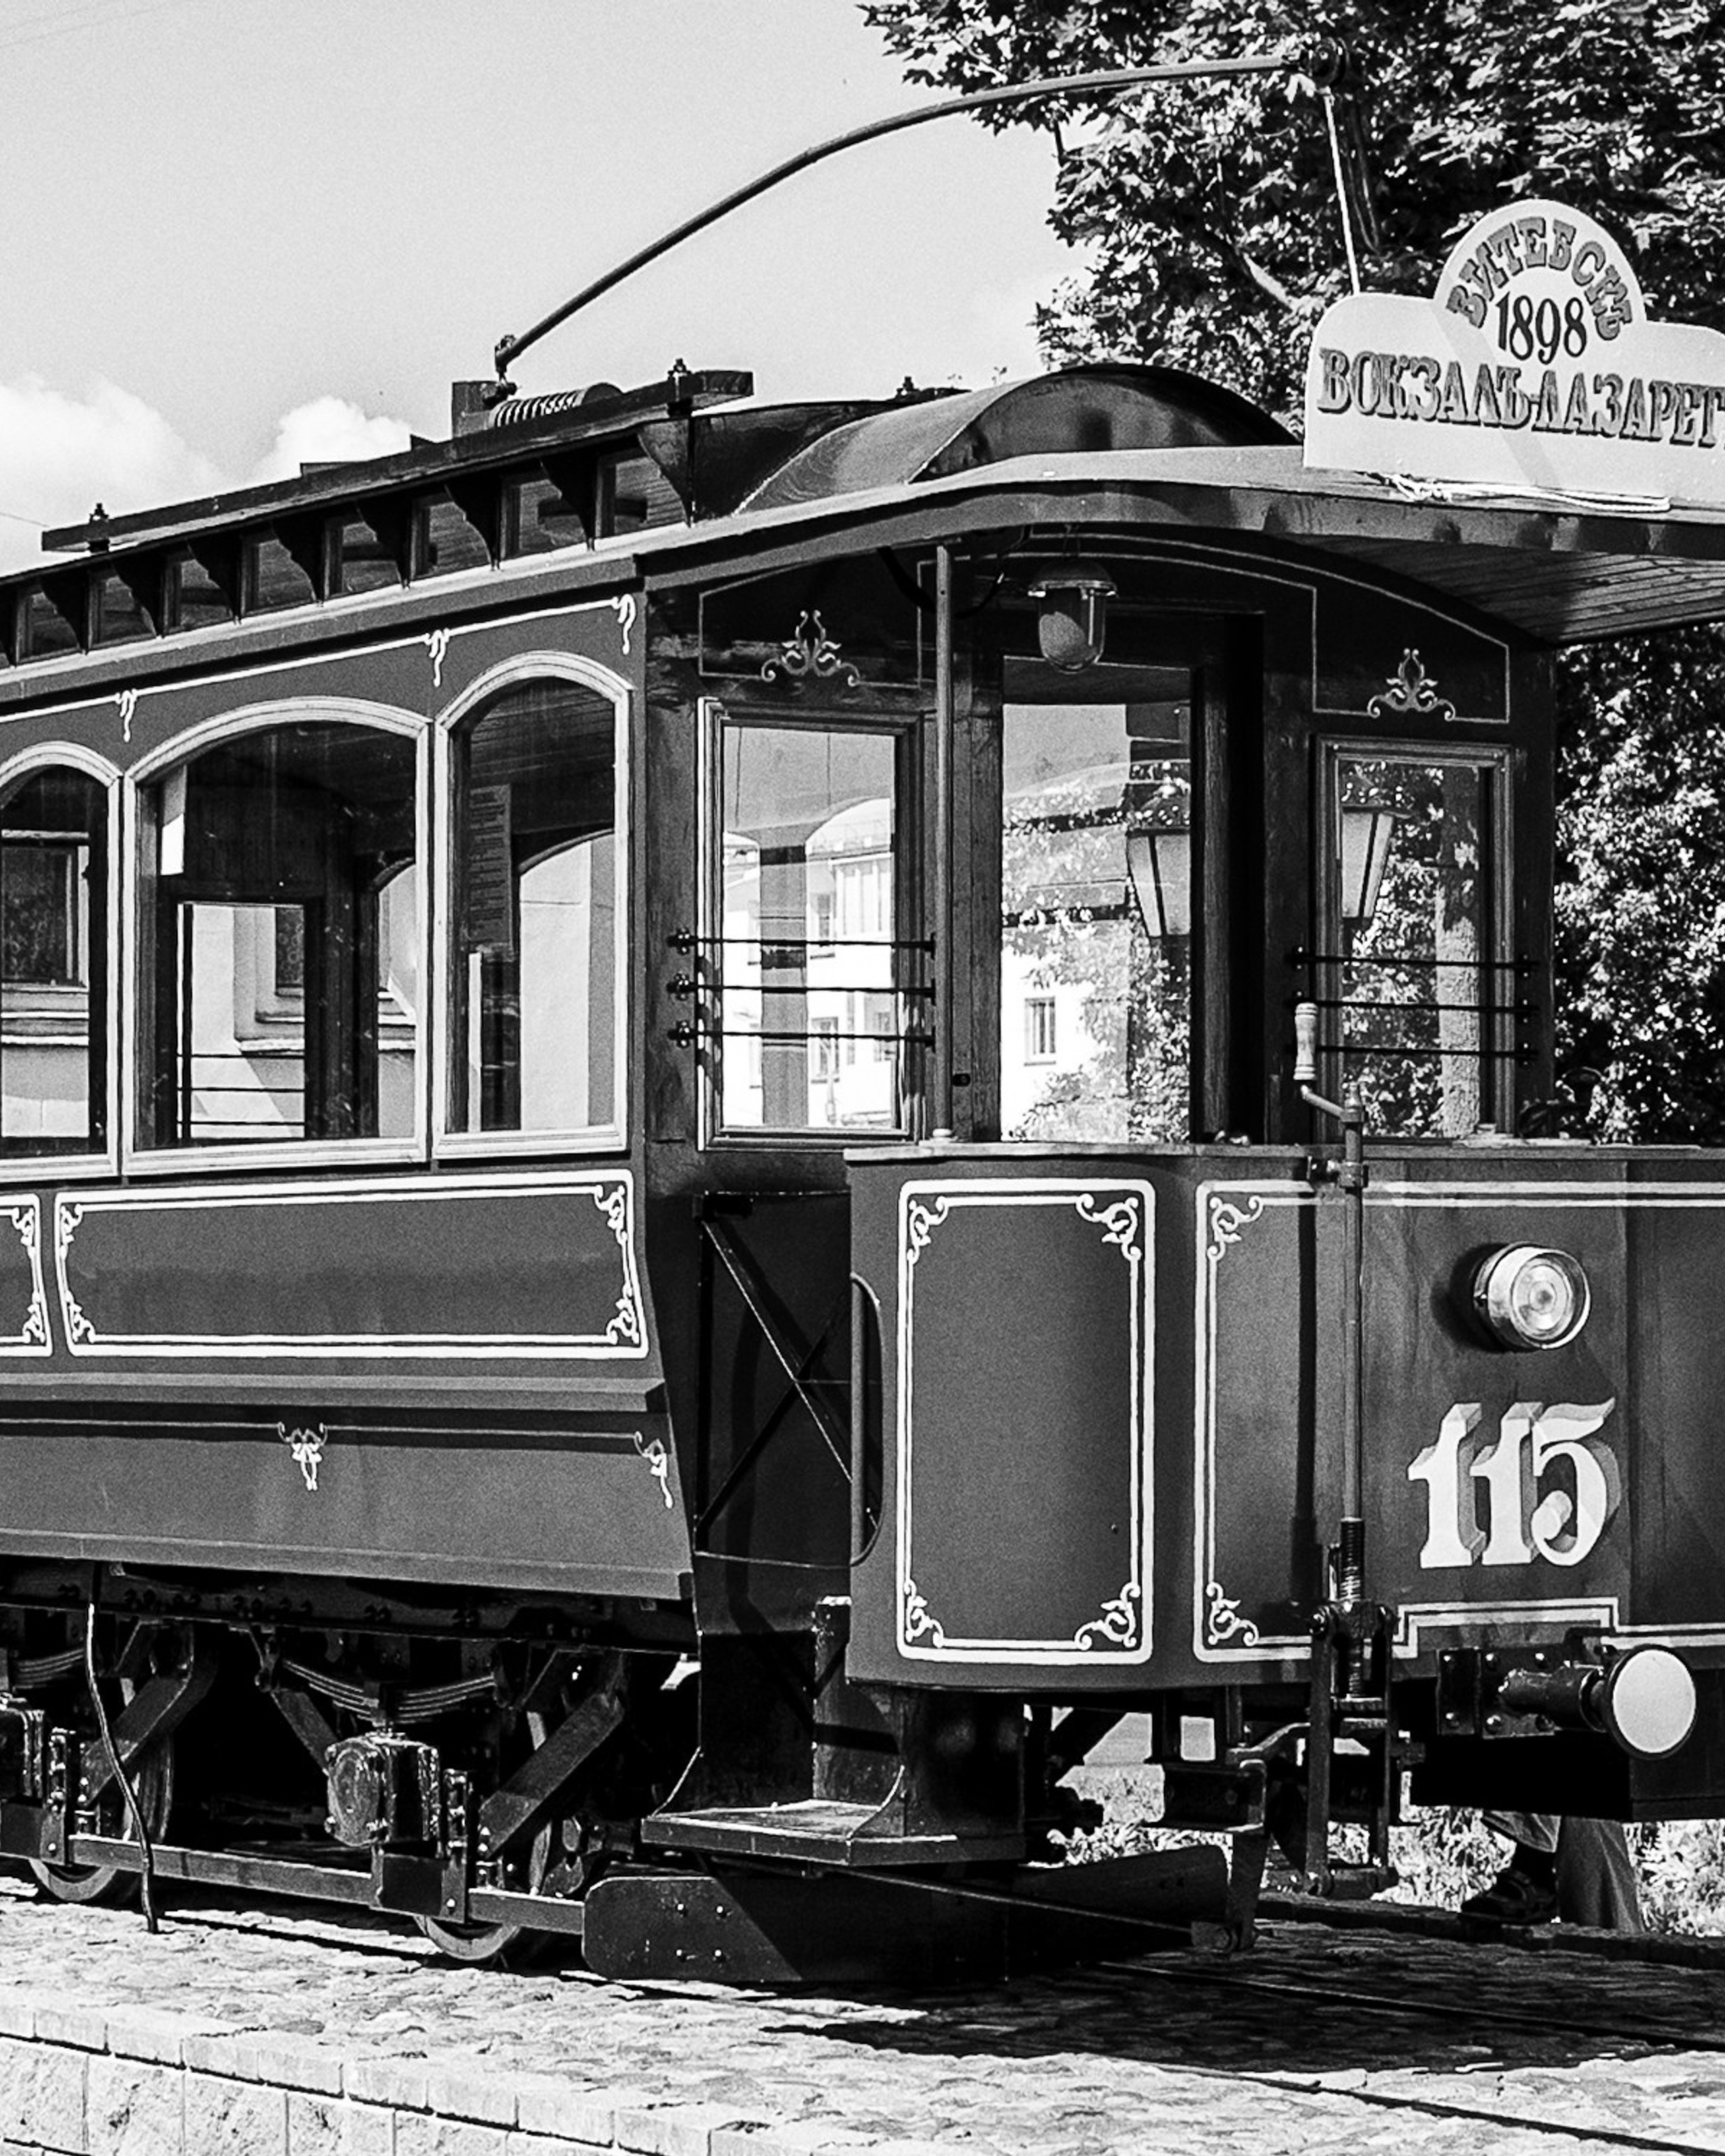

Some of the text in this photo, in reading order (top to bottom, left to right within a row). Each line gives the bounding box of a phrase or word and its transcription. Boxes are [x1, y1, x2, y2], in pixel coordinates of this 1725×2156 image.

[1446, 216, 1632, 341] ВИТЕБСКЪ
[1495, 291, 1587, 364] 1898
[1317, 346, 1725, 449] ВОКЗАЛЪ-ЛАЗАРЕТ
[1407, 1396, 1622, 1569] 115
